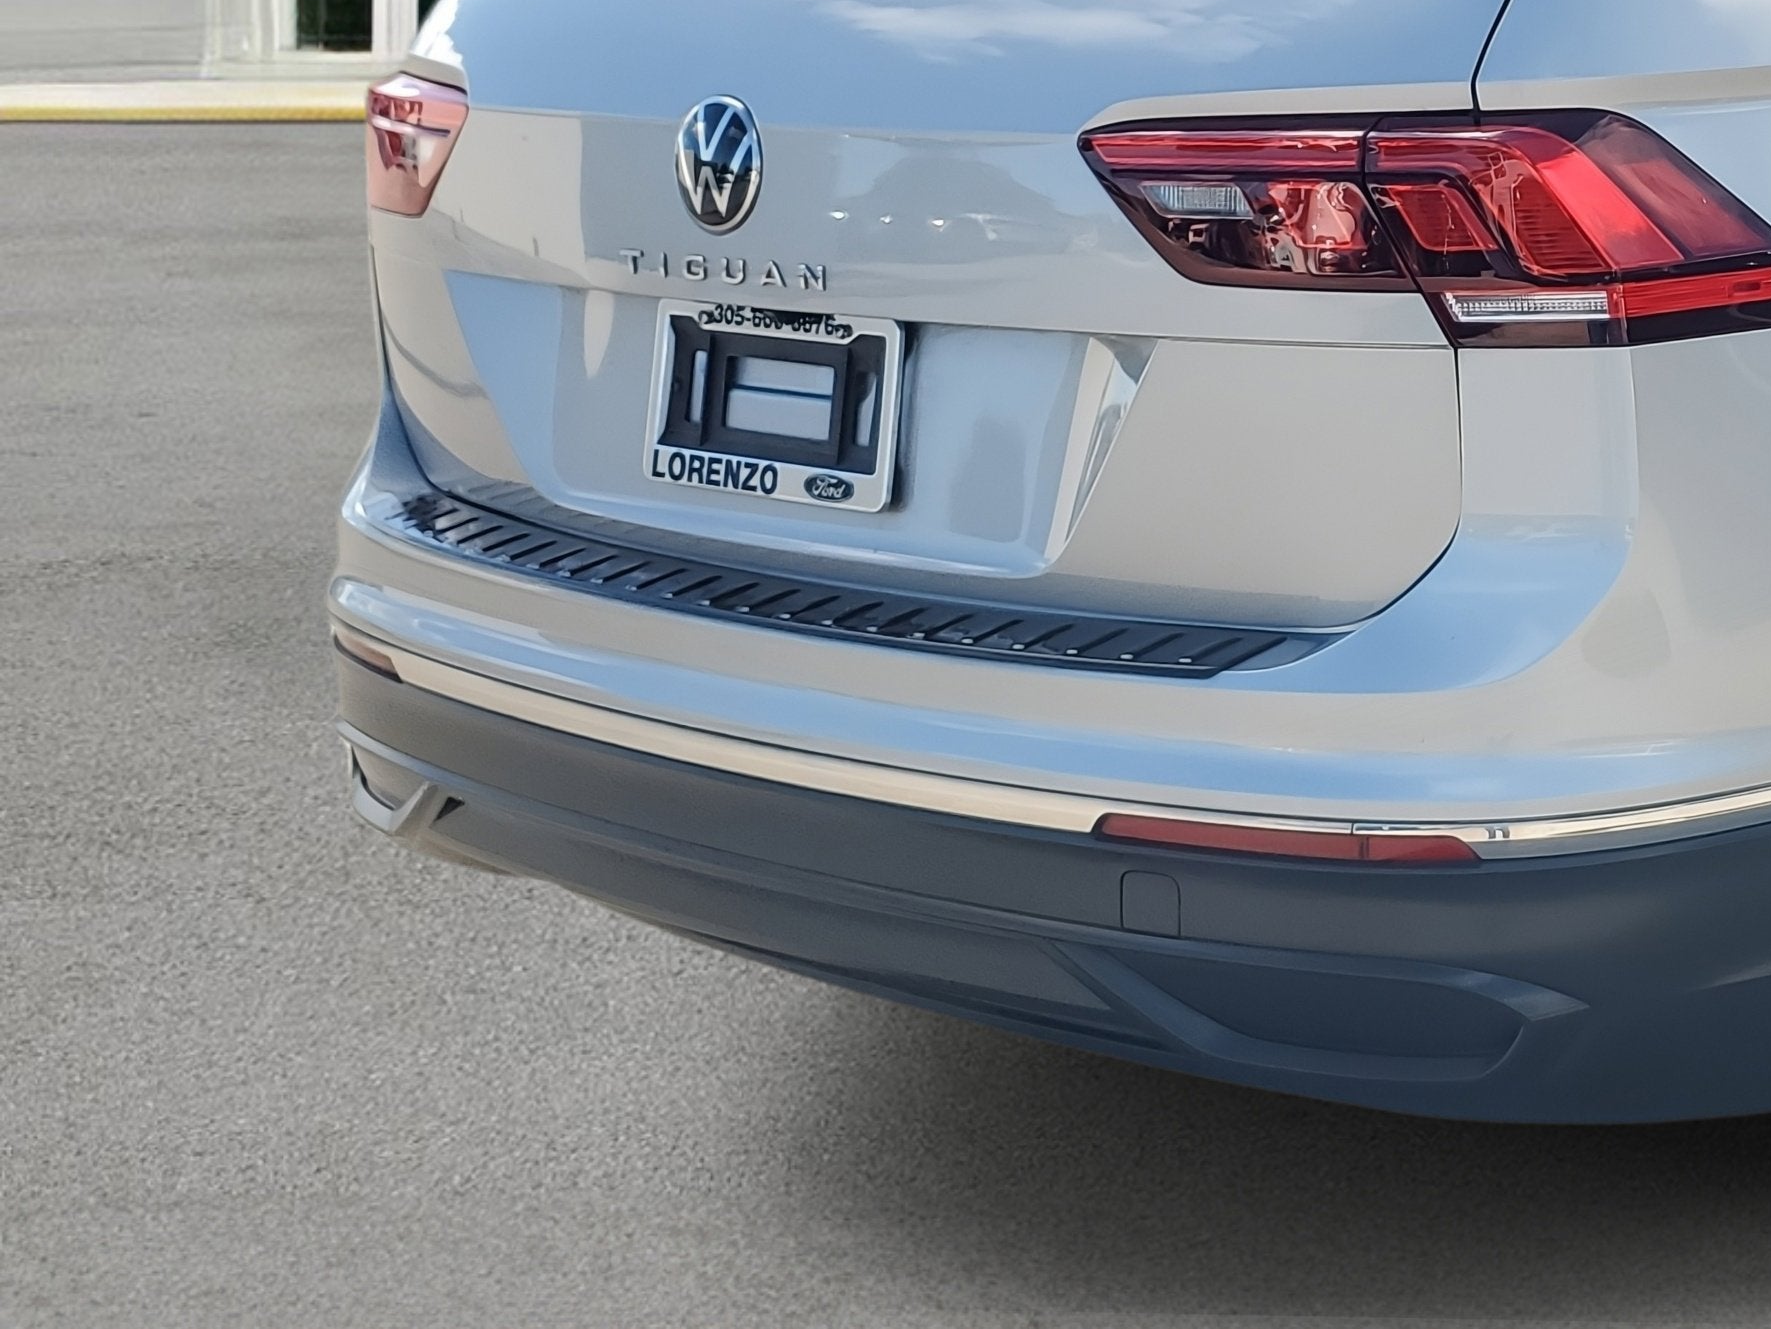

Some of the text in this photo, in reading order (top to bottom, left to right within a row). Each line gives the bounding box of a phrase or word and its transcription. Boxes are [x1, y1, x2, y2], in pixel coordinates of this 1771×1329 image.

[619, 248, 826, 291] TIGUAN
[651, 449, 778, 495] LORENZO
[812, 477, 847, 500] Ford
